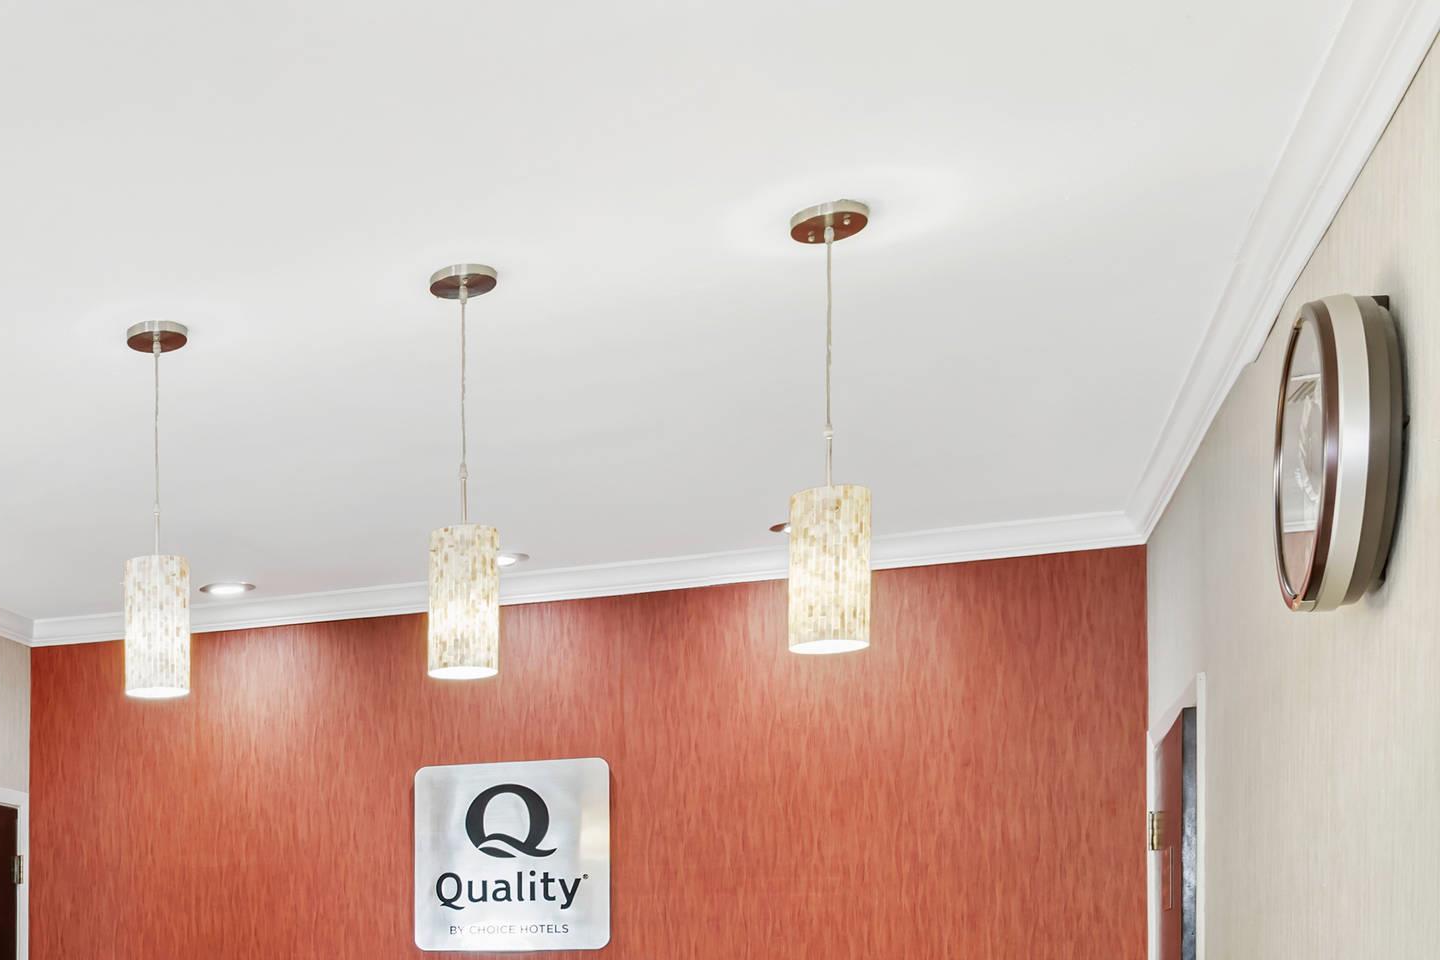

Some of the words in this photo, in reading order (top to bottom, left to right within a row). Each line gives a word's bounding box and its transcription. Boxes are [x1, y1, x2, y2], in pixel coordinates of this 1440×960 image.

[436, 870, 582, 910] Quality
[450, 926, 463, 934] BY
[468, 925, 517, 934] CHOICE
[520, 924, 569, 934] HOTELS
